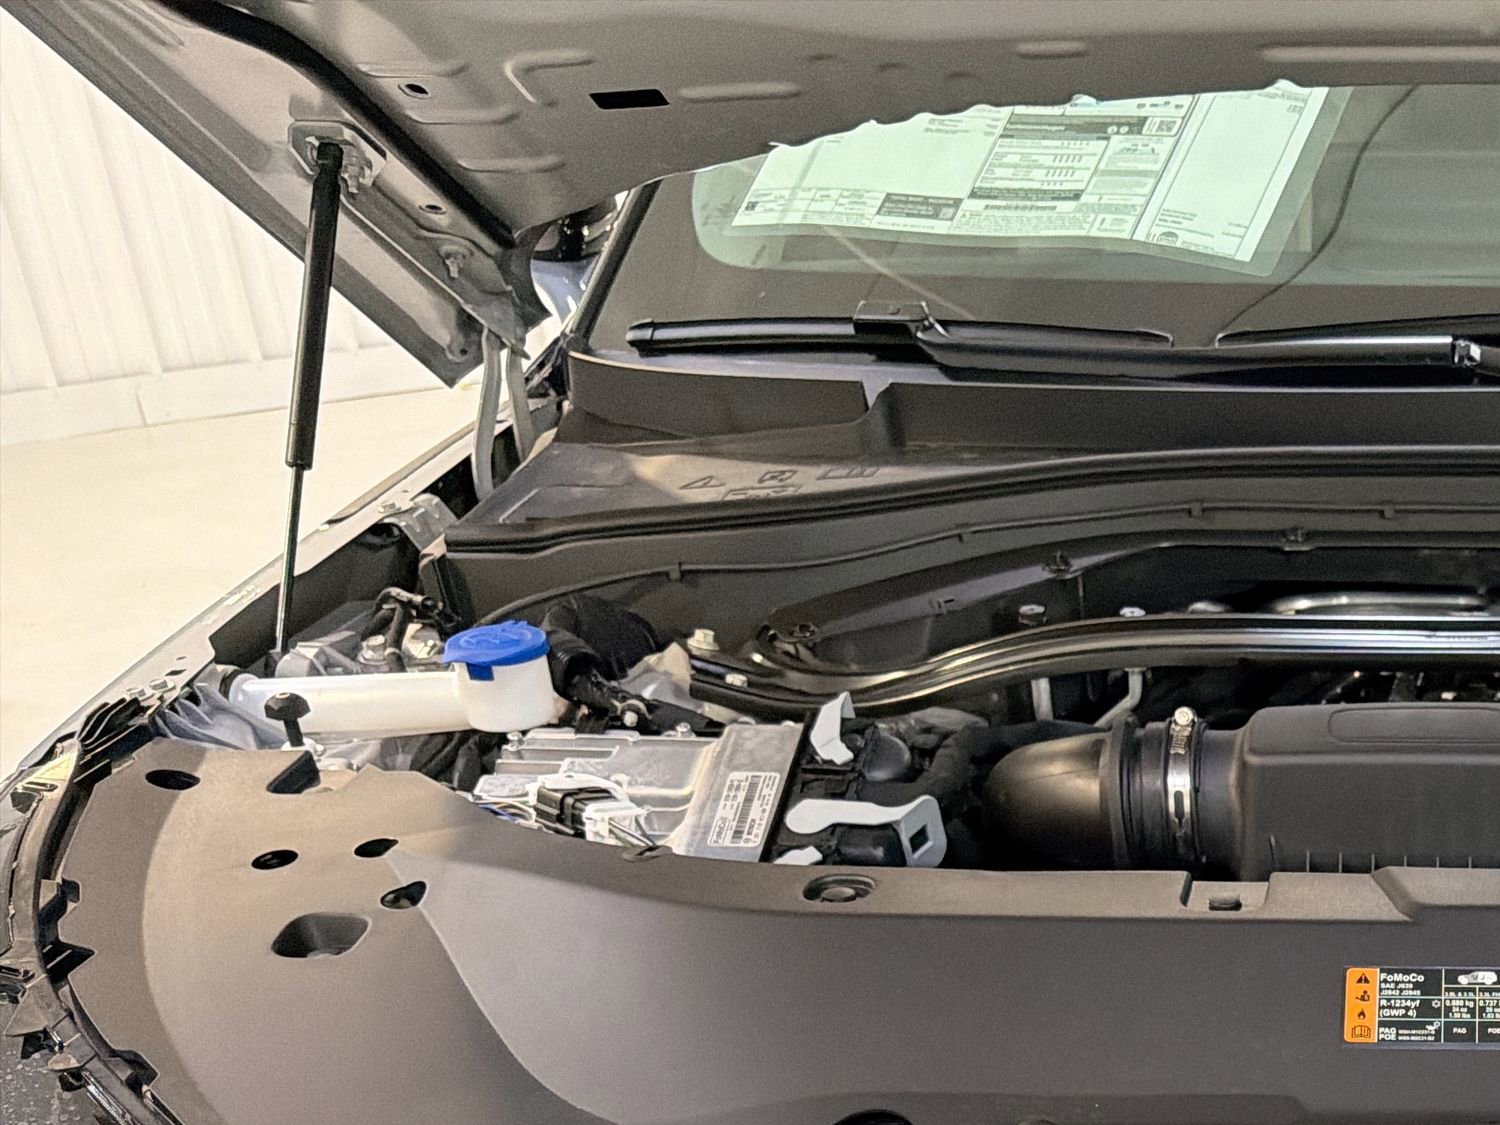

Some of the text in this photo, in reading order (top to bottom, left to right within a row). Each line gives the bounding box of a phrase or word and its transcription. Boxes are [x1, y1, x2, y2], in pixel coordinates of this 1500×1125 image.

[1380, 973, 1425, 982] FoMoCo
[1380, 999, 1420, 1008] R-1234yf
[1466, 1000, 1474, 1008] kg
[1379, 1009, 1417, 1018] (GWP 4)
